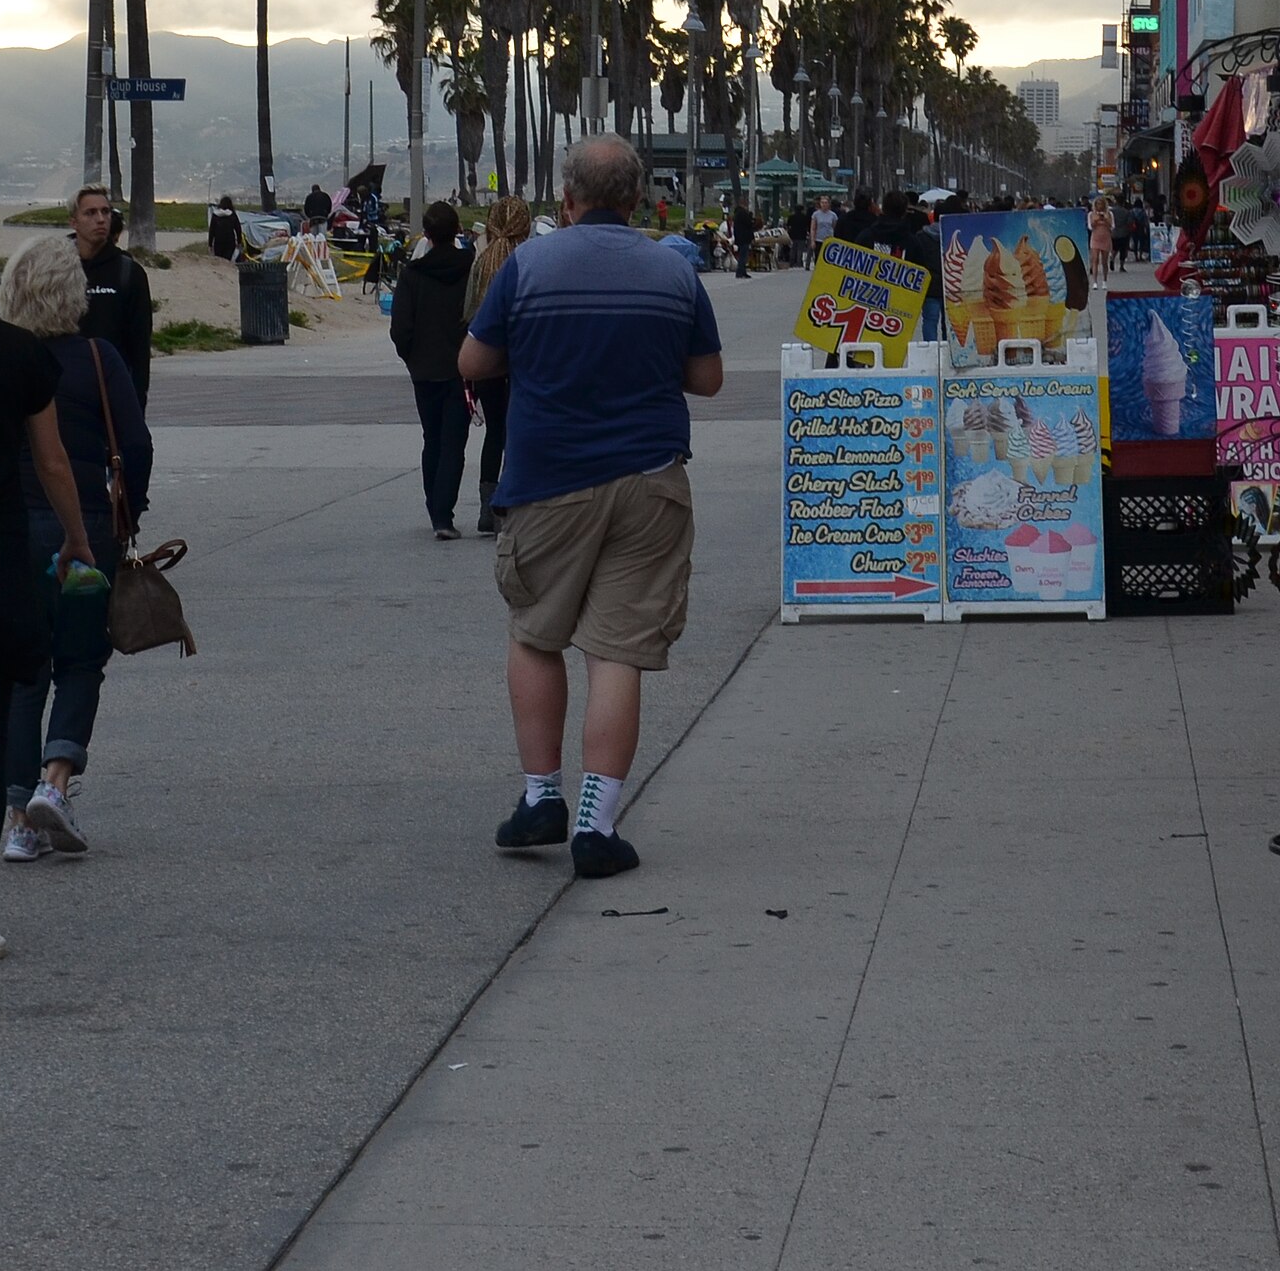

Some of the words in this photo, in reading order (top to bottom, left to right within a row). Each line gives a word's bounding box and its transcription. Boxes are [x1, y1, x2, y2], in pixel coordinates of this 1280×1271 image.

[109, 80, 131, 91] Club
[136, 80, 167, 92] House
[825, 243, 879, 275] GIANT
[877, 260, 926, 291] SLICE
[840, 275, 890, 309] PIZZA
[946, 383, 978, 398] Soft
[979, 383, 1019, 398] Serve
[1022, 381, 1044, 396] Ice
[1047, 381, 1093, 395] Cream
[789, 390, 825, 413] Giant
[827, 388, 862, 407] Slice
[862, 389, 902, 407] Pizza
[789, 418, 837, 441] Grilled
[837, 416, 868, 436] Hot
[869, 418, 902, 439] Dog
[789, 447, 834, 466] Frozen
[836, 445, 903, 464] Lemonade
[788, 472, 846, 497] Cherry
[848, 469, 902, 491] Slush
[1018, 485, 1077, 503] Funnel
[789, 498, 856, 518] Rootbeer
[860, 497, 902, 518] Float
[1017, 504, 1070, 521] Cakes
[789, 524, 814, 544] Ice
[815, 523, 863, 544] Cream
[865, 525, 905, 543] Cone
[851, 551, 905, 572] Churro
[953, 548, 1008, 563] Slushies
[961, 567, 1000, 580] Frozen
[1015, 565, 1035, 573] Cherry
[953, 576, 1012, 589] Lemonade
[1043, 579, 1062, 587] Cherry
